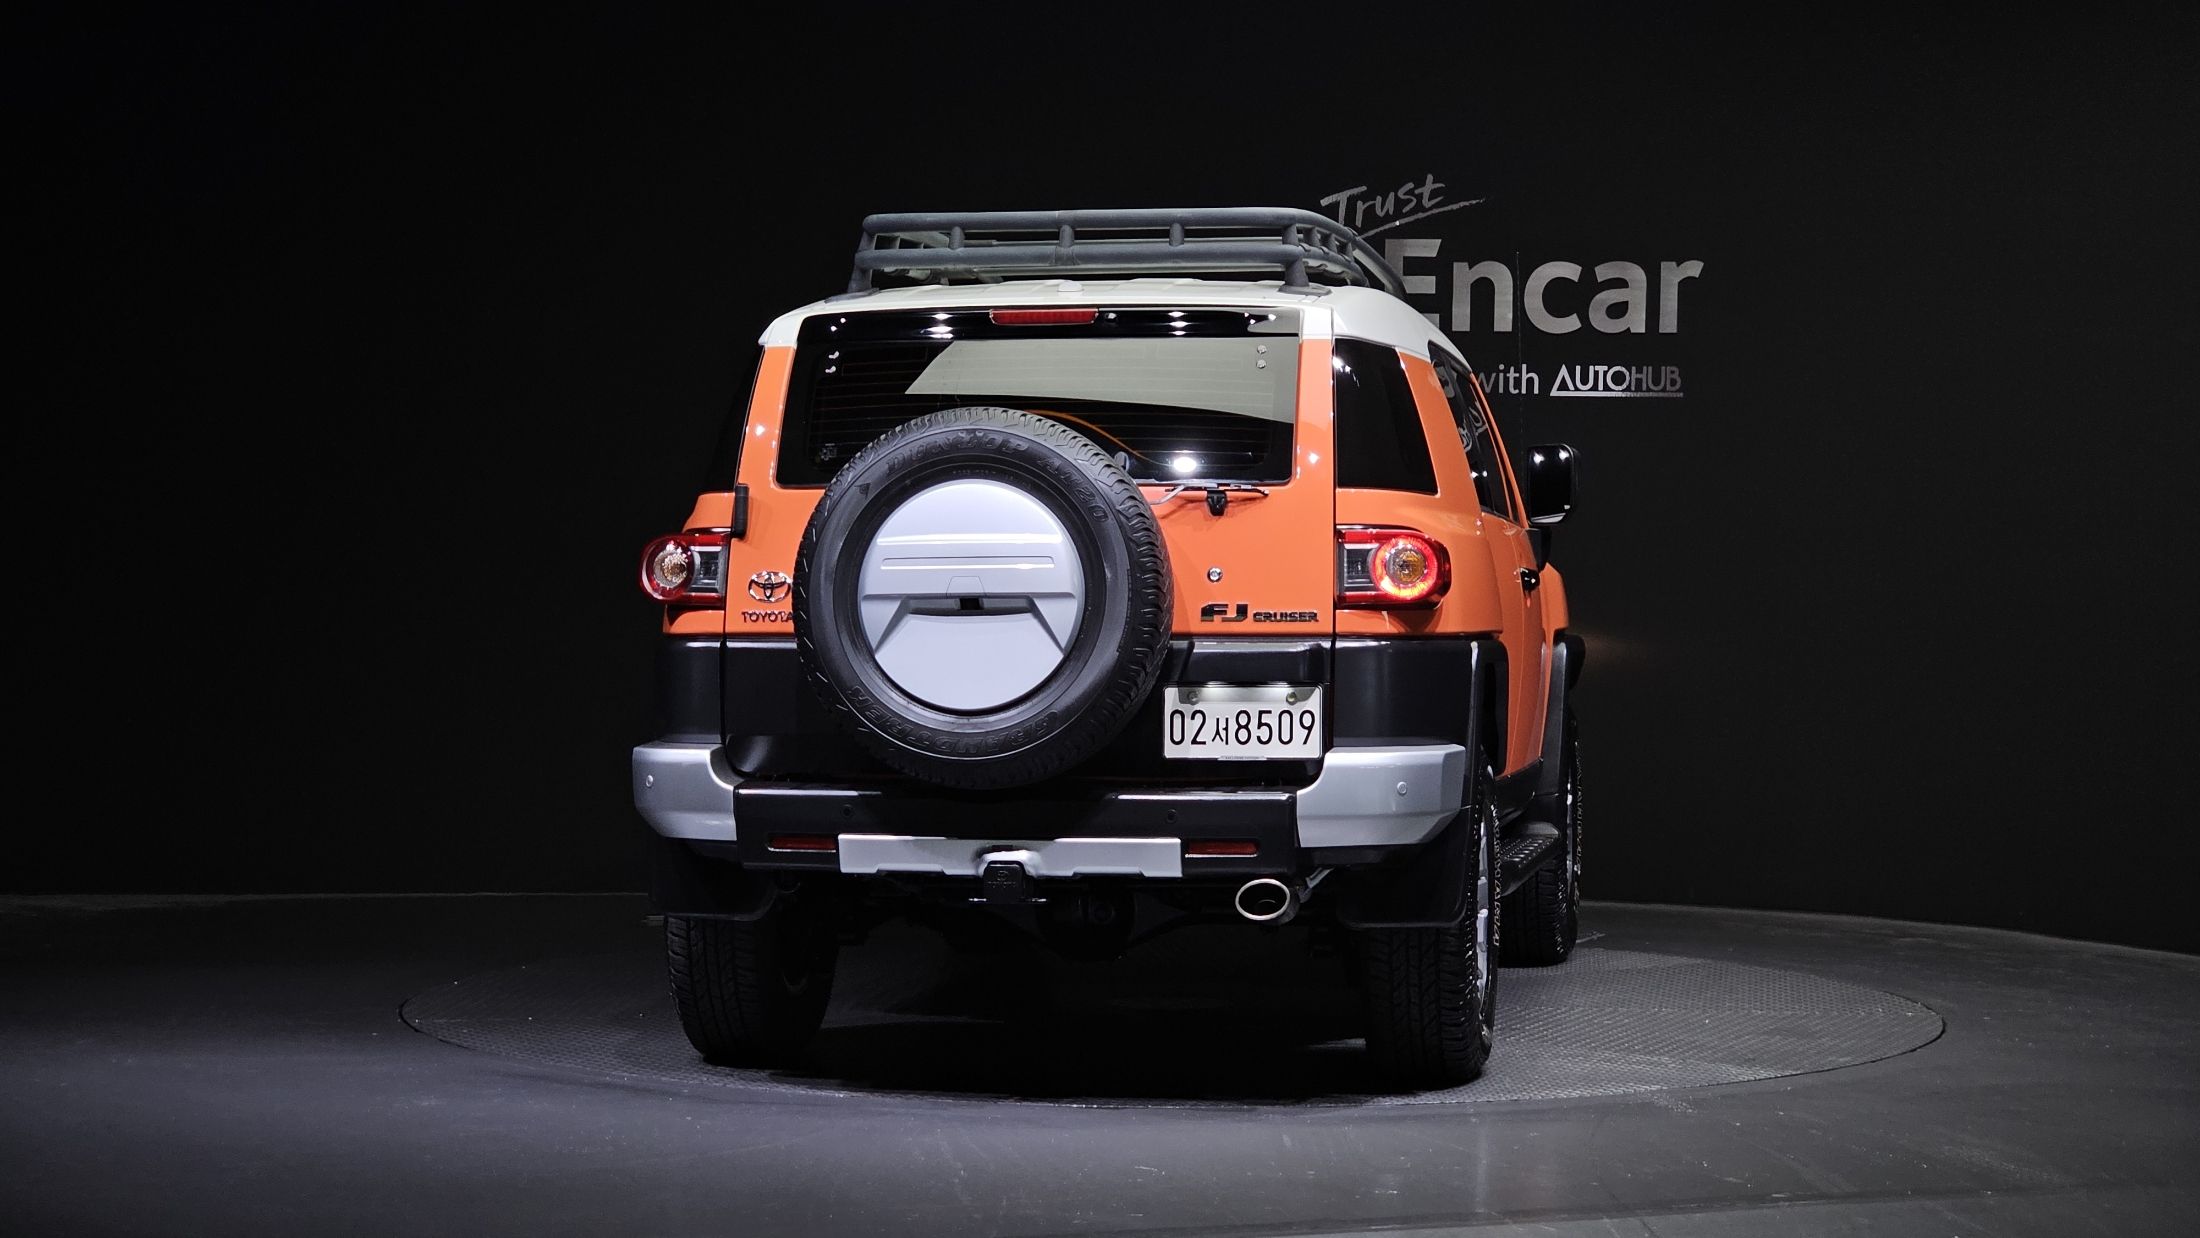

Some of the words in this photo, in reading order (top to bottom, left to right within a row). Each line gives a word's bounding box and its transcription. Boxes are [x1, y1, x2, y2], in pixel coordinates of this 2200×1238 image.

[1320, 173, 1446, 228] Trust
[1384, 238, 1705, 335] Encar
[1550, 363, 1683, 396] AUTOHUB
[741, 611, 794, 623] TOYOTA
[1200, 603, 1249, 623] FJ
[1252, 611, 1320, 623] CRUISER
[1169, 709, 1316, 746] 02서8509
